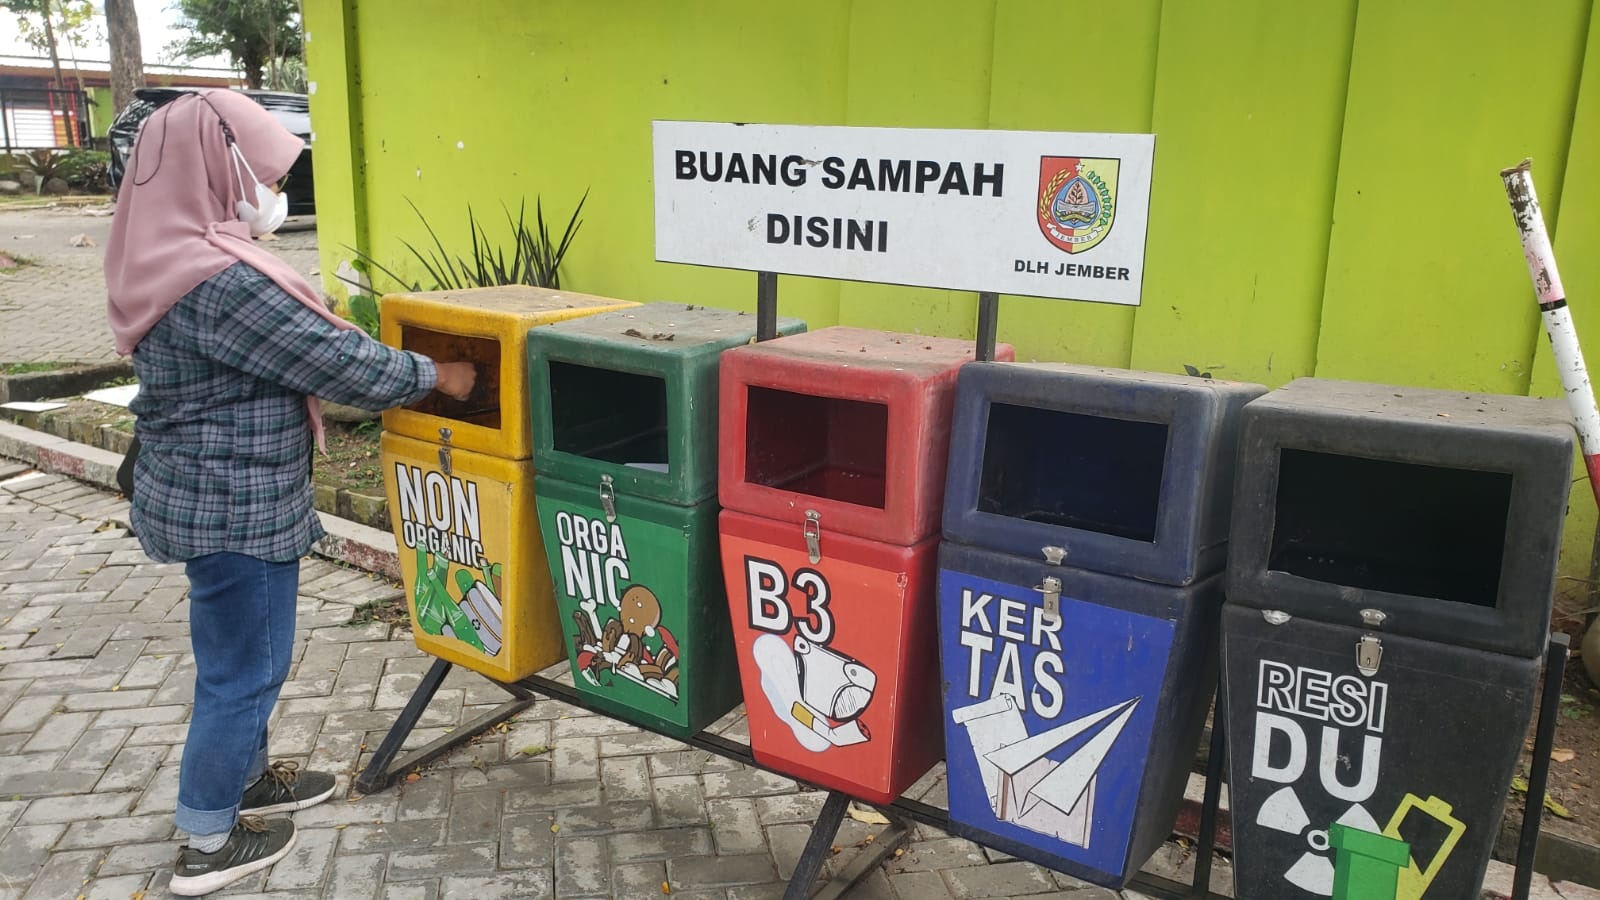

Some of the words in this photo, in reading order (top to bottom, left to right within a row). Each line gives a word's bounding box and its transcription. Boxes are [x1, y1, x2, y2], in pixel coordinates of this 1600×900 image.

[675, 150, 807, 186] BUANG
[821, 156, 1004, 198] SAMPAH
[766, 213, 888, 253] DISINI
[1014, 260, 1049, 275] DLH
[1055, 263, 1130, 281] JEMBER
[395, 462, 481, 542] NON
[402, 519, 484, 569] ORGANIC
[556, 511, 629, 561] ORGA
[561, 544, 630, 609] NIC
[744, 555, 834, 645] B3
[961, 588, 1063, 651] KER
[960, 630, 1065, 720] TAS
[1256, 659, 1388, 733] RESI
[1251, 711, 1383, 802] DU
